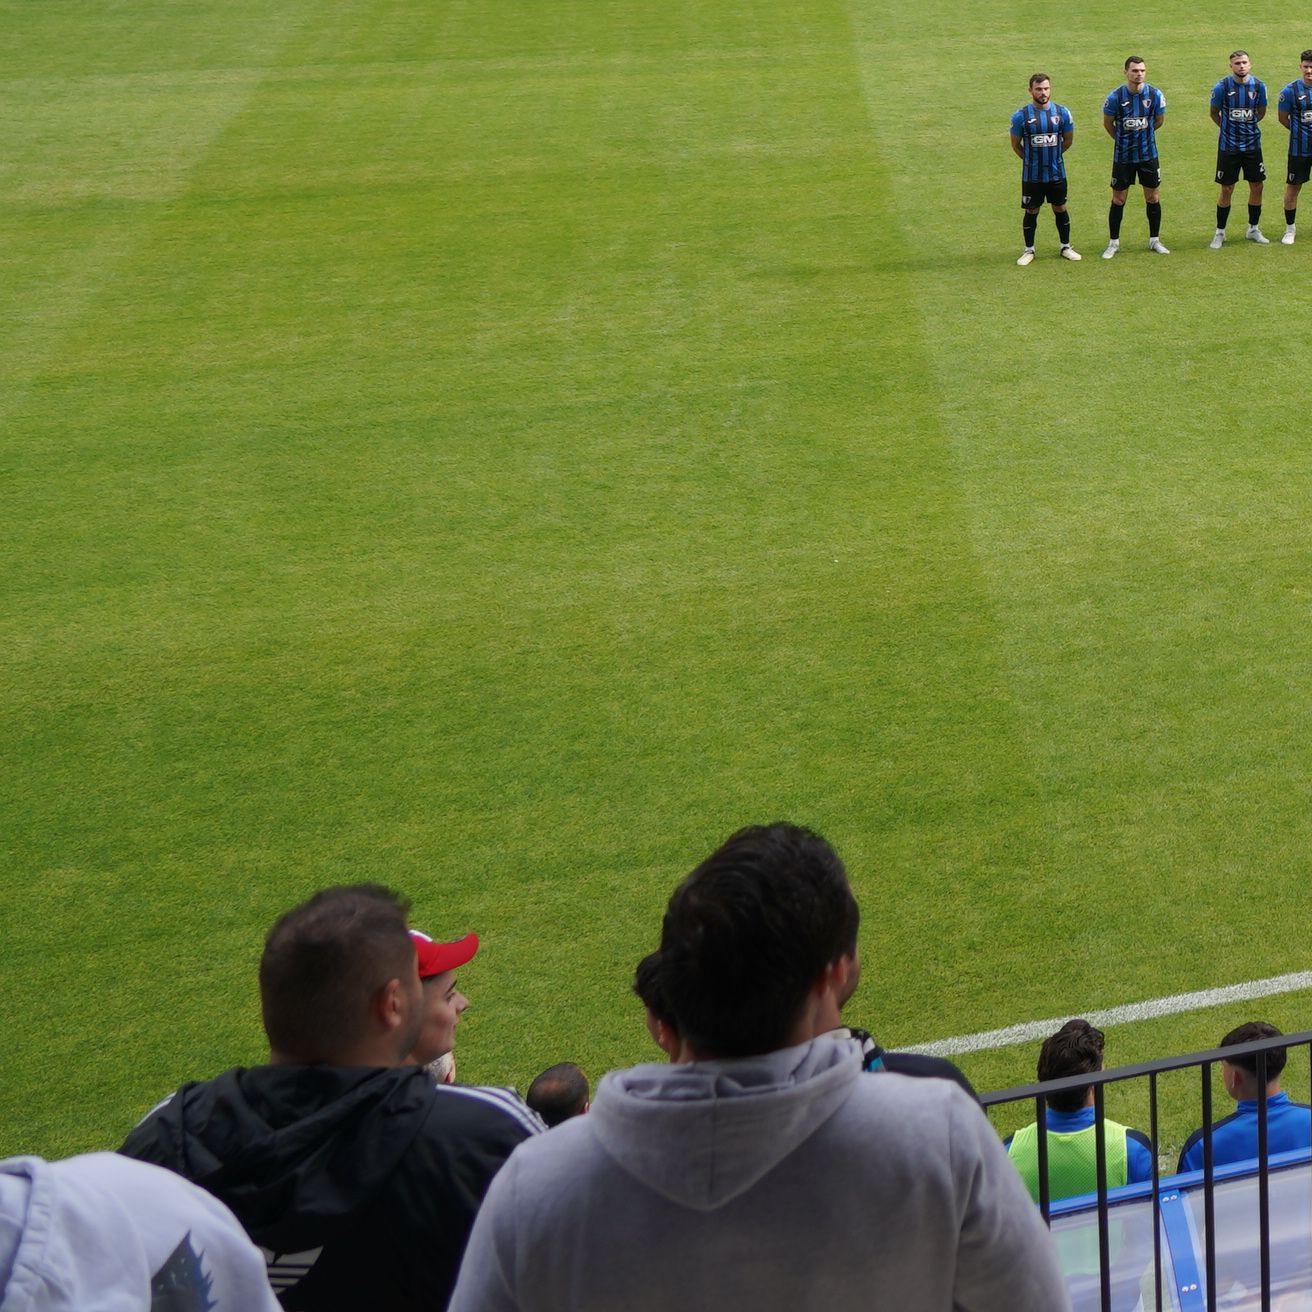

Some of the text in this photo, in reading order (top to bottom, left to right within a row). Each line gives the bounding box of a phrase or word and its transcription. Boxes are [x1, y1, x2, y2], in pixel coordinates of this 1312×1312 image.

[1231, 109, 1252, 118] GM
[1125, 118, 1147, 128] GM
[1033, 135, 1057, 143] GM
